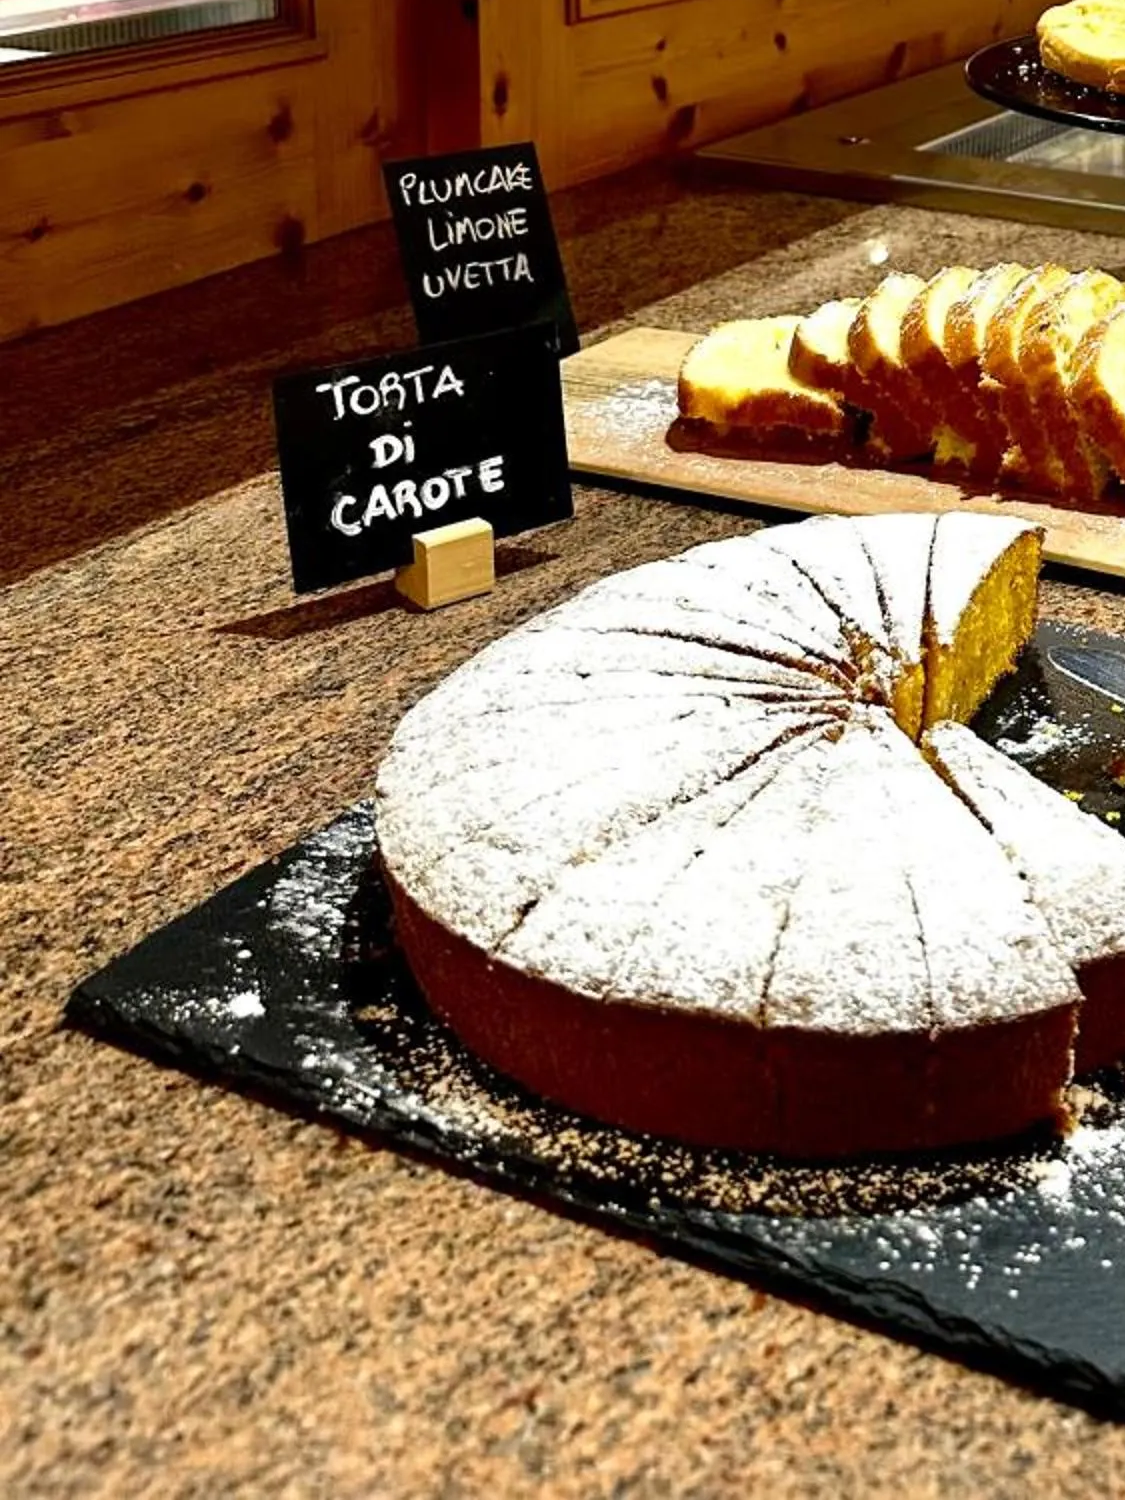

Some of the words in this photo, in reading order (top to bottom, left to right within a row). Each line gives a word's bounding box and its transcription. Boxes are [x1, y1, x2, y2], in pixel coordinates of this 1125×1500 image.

[399, 162, 533, 206] PLUMCAKE
[422, 252, 535, 298] UVETTA
[315, 364, 465, 421] TORTA
[330, 455, 505, 537] CAROTE
